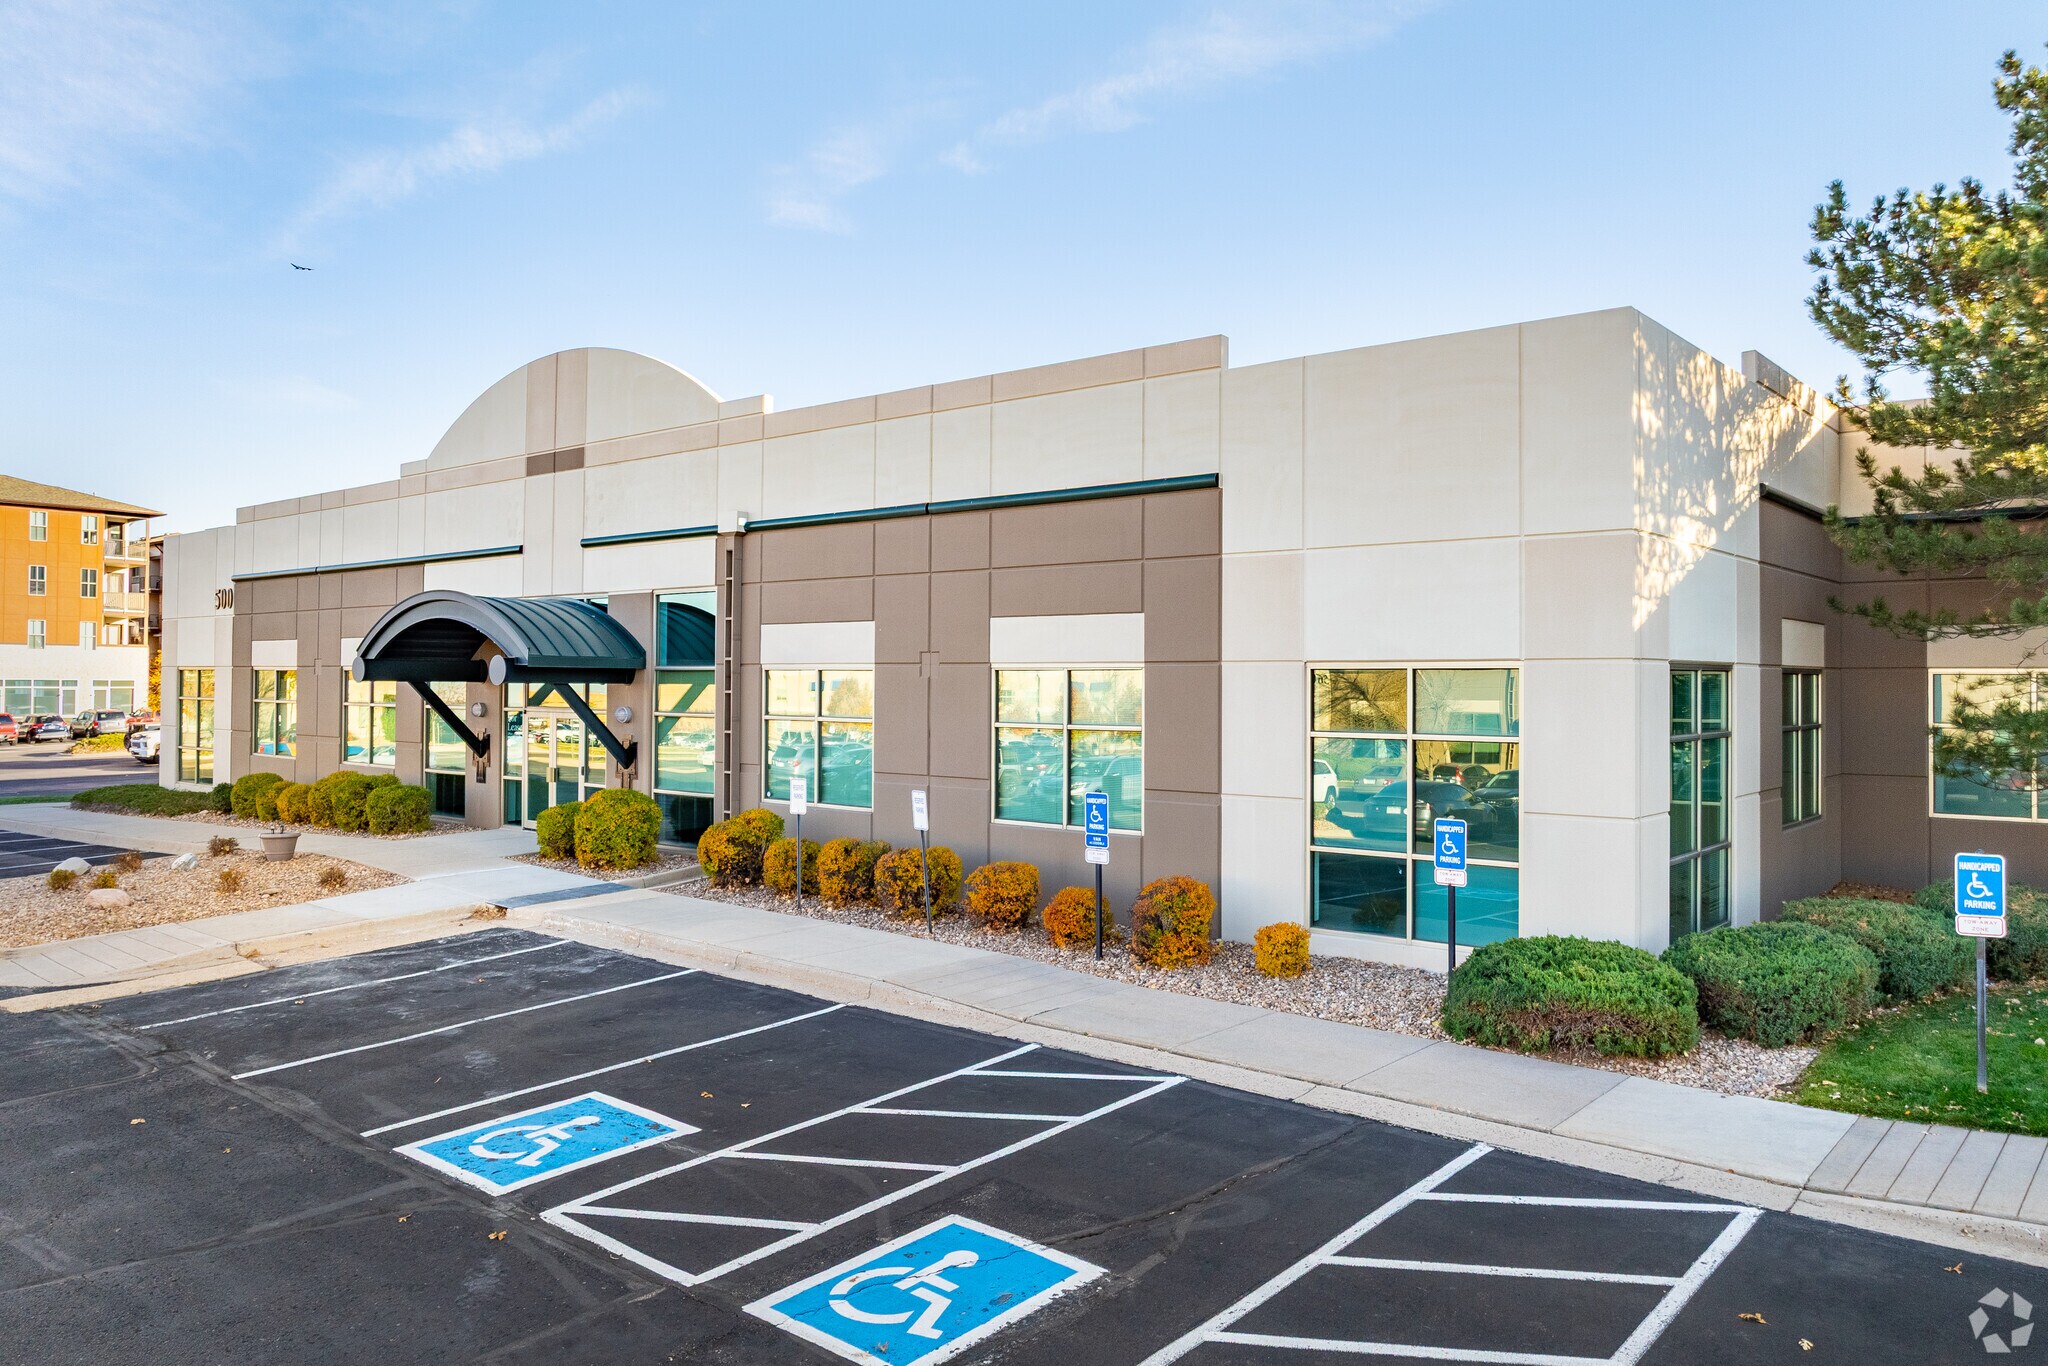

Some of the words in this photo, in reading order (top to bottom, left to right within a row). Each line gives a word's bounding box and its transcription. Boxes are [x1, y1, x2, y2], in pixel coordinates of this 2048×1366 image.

[215, 588, 233, 609] 500
[1436, 824, 1464, 833] HANDICAPPED
[1439, 855, 1461, 864] PARKING
[1958, 861, 2002, 872] HANDICAPPED
[1963, 899, 1997, 911] PARKING
